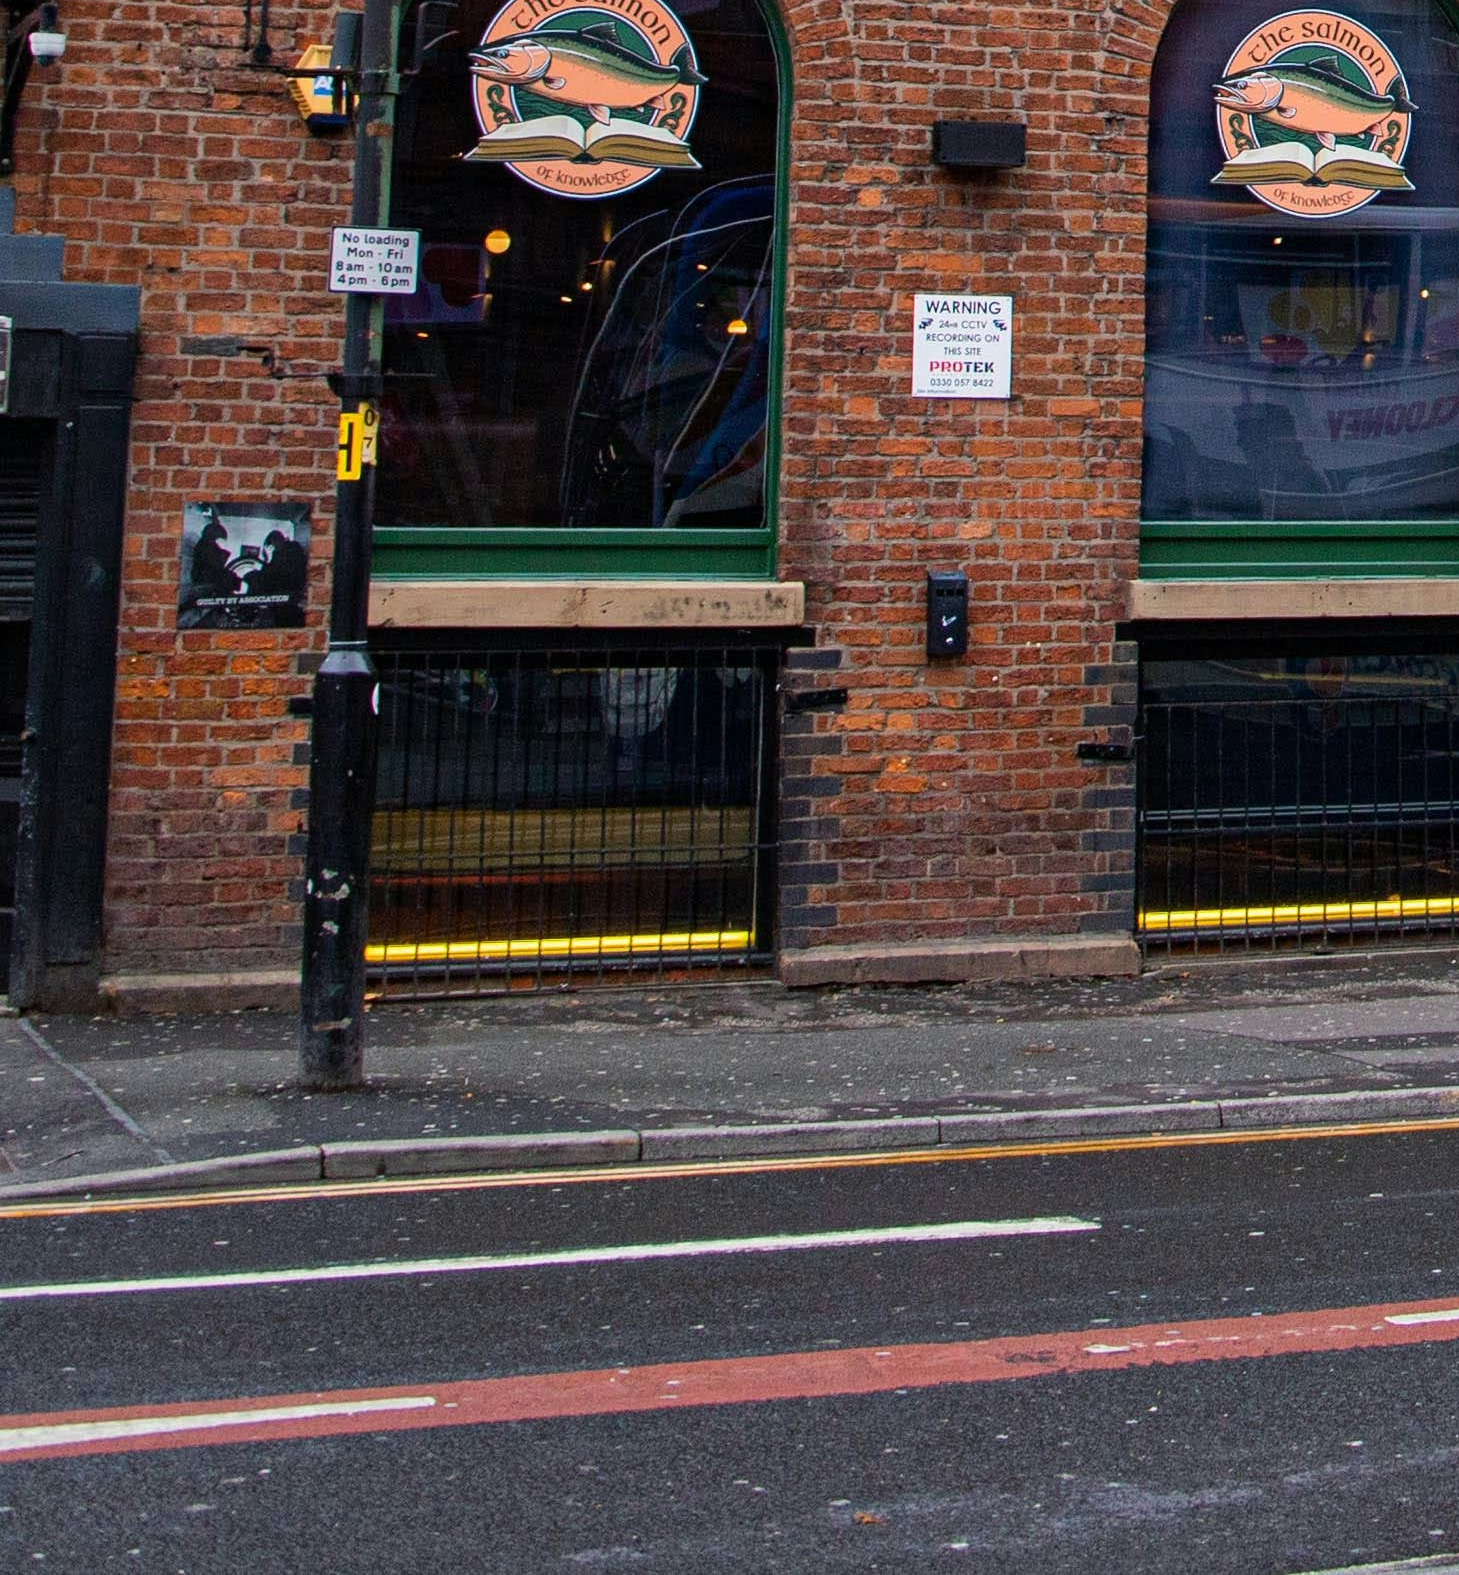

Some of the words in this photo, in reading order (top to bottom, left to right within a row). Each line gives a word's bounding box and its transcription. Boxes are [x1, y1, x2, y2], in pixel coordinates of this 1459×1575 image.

[1248, 25, 1295, 64] The
[342, 232, 360, 244] No
[364, 233, 410, 248] loading
[346, 247, 374, 258] Mon
[387, 248, 405, 260] Fri
[925, 300, 1002, 315] WARNING
[961, 320, 988, 329] CCTV
[925, 333, 982, 343] RECORDING
[984, 333, 1000, 343] ON
[943, 347, 962, 356] THIS
[964, 347, 982, 356] SITE
[929, 360, 995, 373] PROTEK
[930, 378, 952, 387] 0330
[954, 378, 970, 387] 057
[972, 379, 994, 387] 8422
[226, 597, 237, 605] BY
